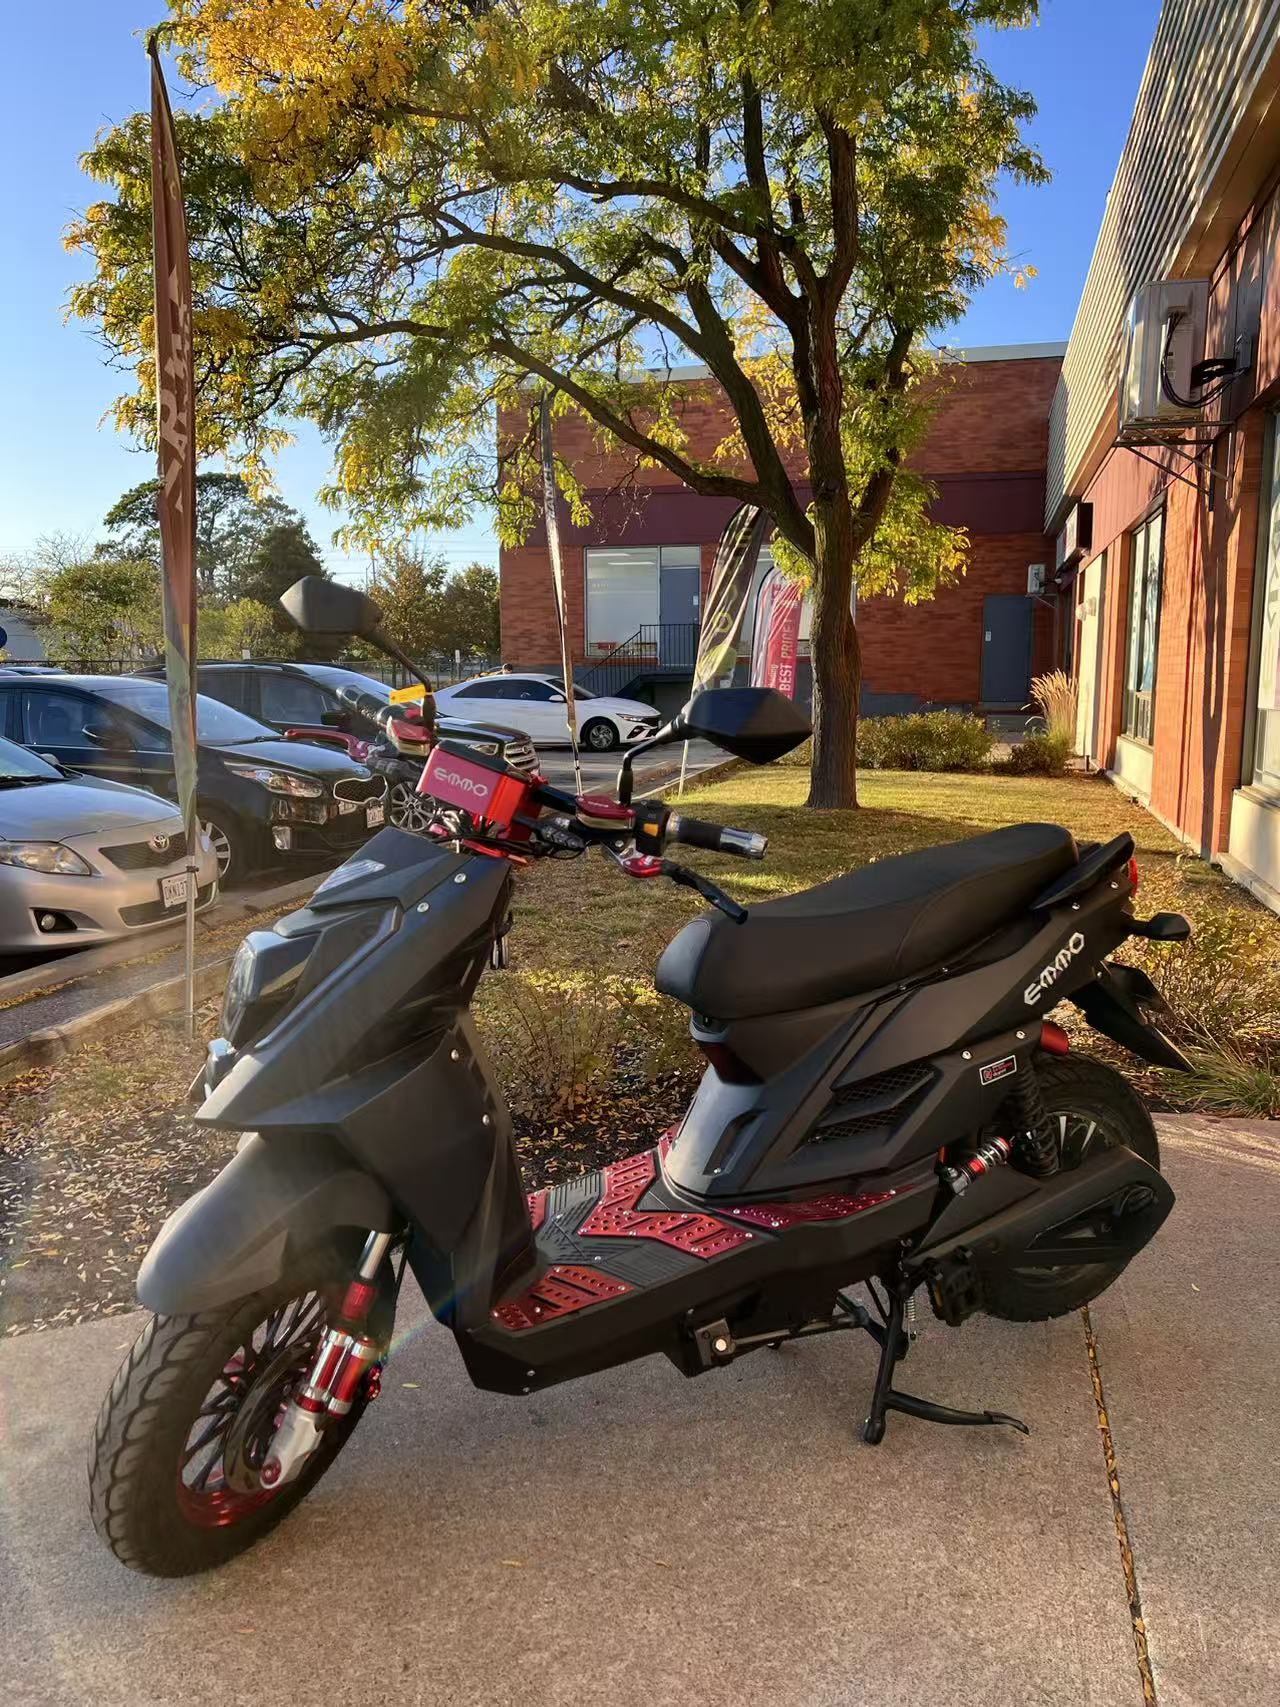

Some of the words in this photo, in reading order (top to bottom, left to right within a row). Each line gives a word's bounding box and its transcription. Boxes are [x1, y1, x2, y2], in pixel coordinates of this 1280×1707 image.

[779, 663, 793, 691] BEST
[433, 767, 488, 797] EMMO
[1023, 931, 1085, 1006] EMMO
